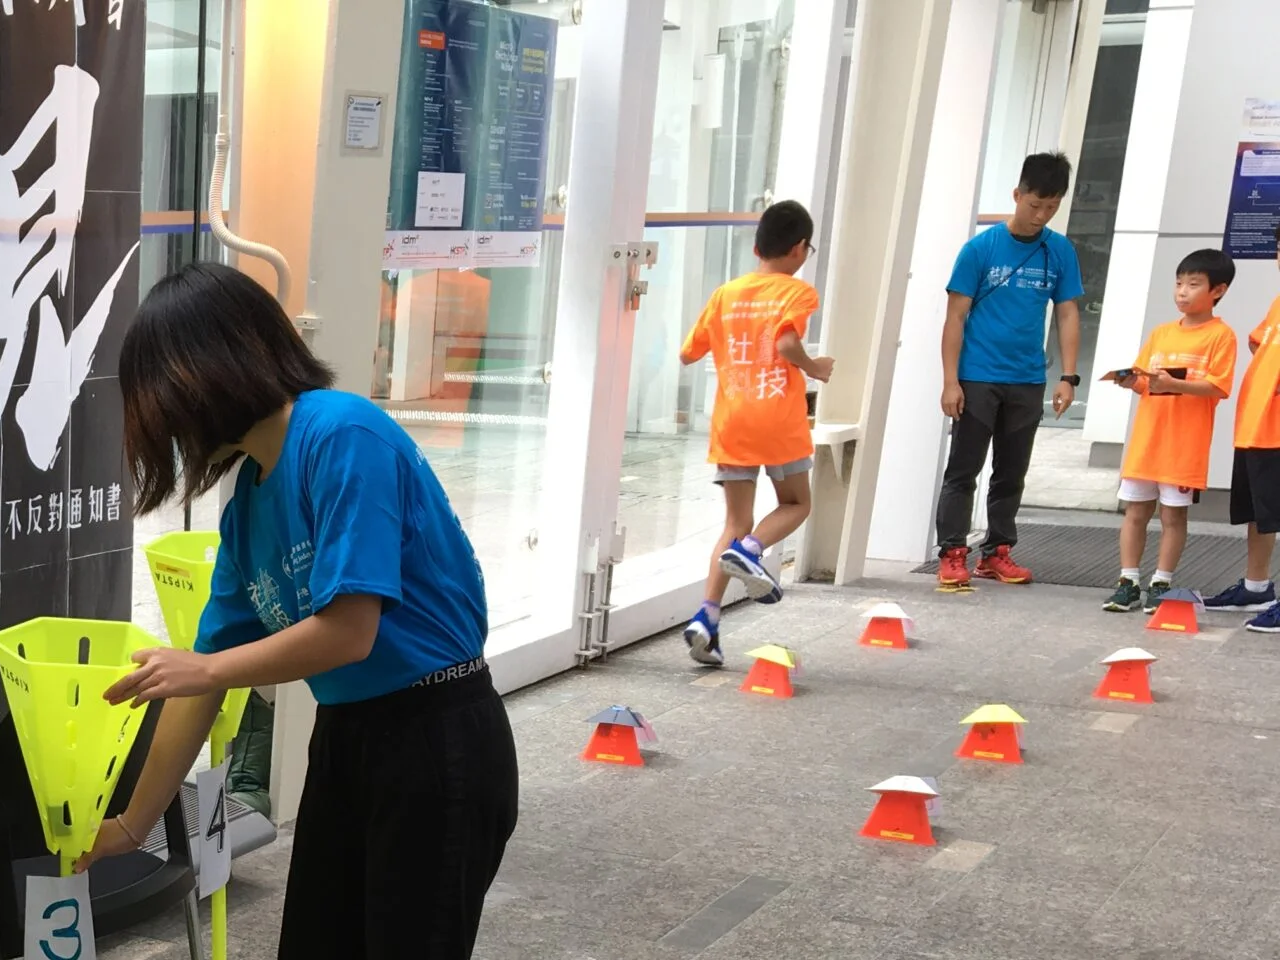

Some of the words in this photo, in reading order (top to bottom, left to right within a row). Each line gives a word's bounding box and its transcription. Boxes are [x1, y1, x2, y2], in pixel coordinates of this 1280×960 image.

[154, 571, 195, 593] KIPSTA
[411, 656, 486, 688] AYDREAM
[205, 785, 226, 853] 4
